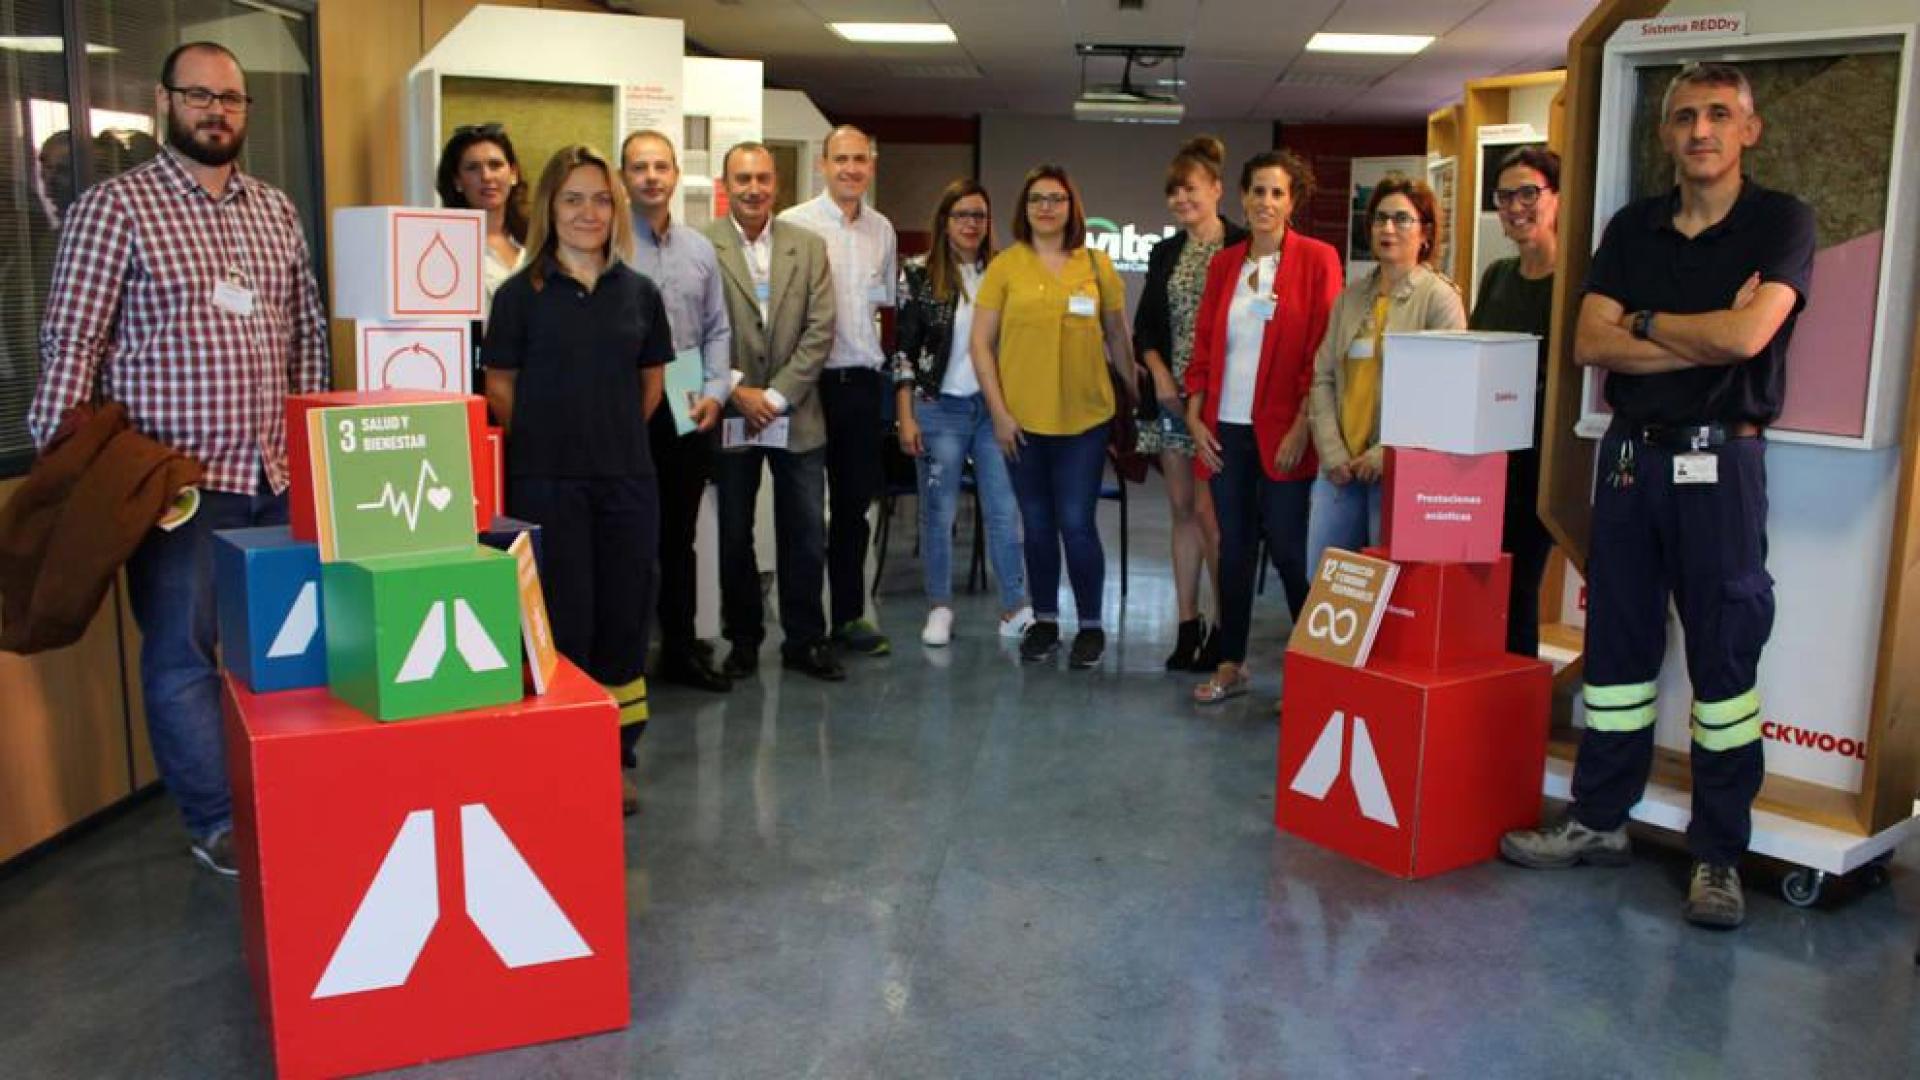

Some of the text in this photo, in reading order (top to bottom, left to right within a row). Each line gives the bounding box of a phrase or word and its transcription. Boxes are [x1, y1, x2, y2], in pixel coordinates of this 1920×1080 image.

[1642, 18, 1740, 34] Sistema REDDry
[338, 418, 356, 453] 3
[361, 416, 401, 431] SALUD
[363, 433, 426, 451] BIENESTAR
[1416, 493, 1482, 505] Prestaciones
[1761, 721, 1867, 760] CKWOOL
